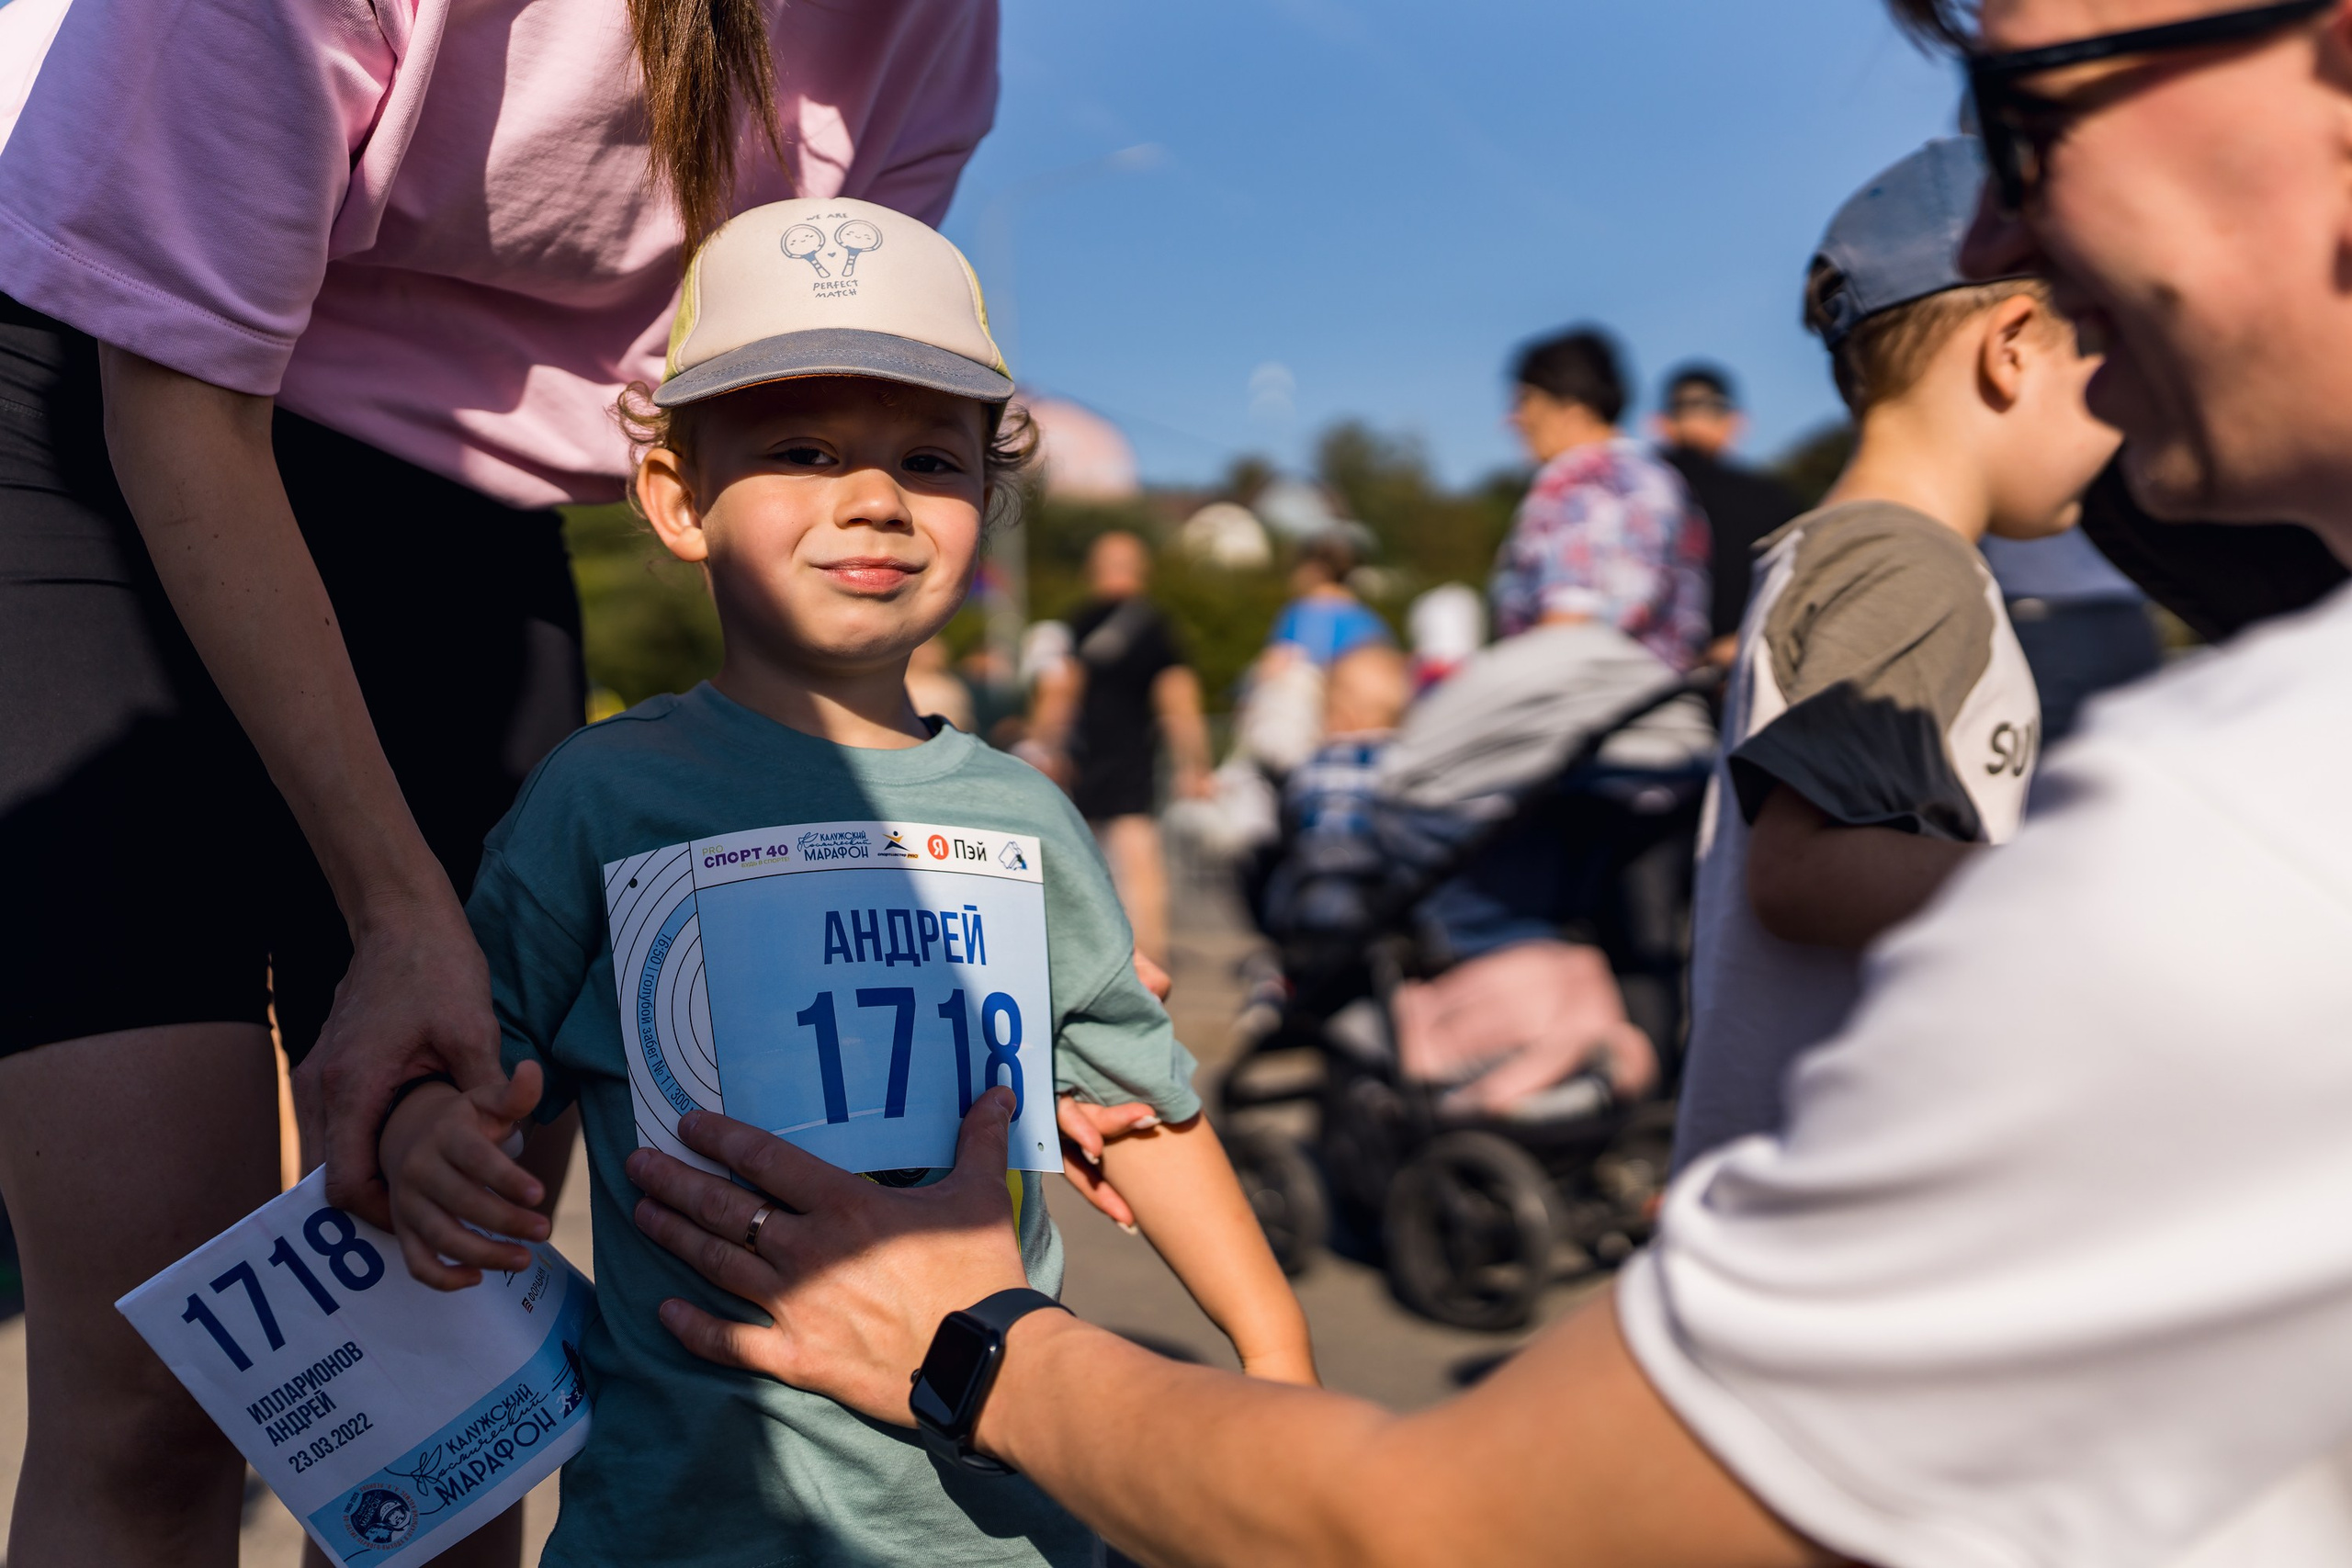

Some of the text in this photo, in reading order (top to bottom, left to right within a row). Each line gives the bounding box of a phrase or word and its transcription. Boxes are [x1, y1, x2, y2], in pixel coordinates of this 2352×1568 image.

[813, 279, 858, 291] PERFECT
[815, 288, 857, 299] MATCH
[702, 845, 724, 856] PRO
[820, 830, 866, 841] КАЛУЖСКИЙ
[954, 839, 987, 862] Пэй
[704, 844, 789, 869] СПОРТ 40
[804, 846, 869, 862] МАРАФОН
[650, 933, 673, 965] 16:50
[823, 904, 988, 967] АНДРЕЙ
[639, 974, 655, 1024] голубой
[642, 1027, 659, 1059] забег
[797, 987, 1024, 1125] 1718
[661, 1076, 672, 1086] 1
[670, 1088, 690, 1111] 300
[181, 1206, 385, 1372] 1718
[246, 1341, 364, 1425] ИЛЛАРИОНОВ
[265, 1389, 337, 1447] АНДРЕЙ
[445, 1382, 534, 1455] КАЛУЖСКИЙ
[288, 1412, 374, 1474] 23.03.2022
[434, 1407, 557, 1506] МАРАФОН
